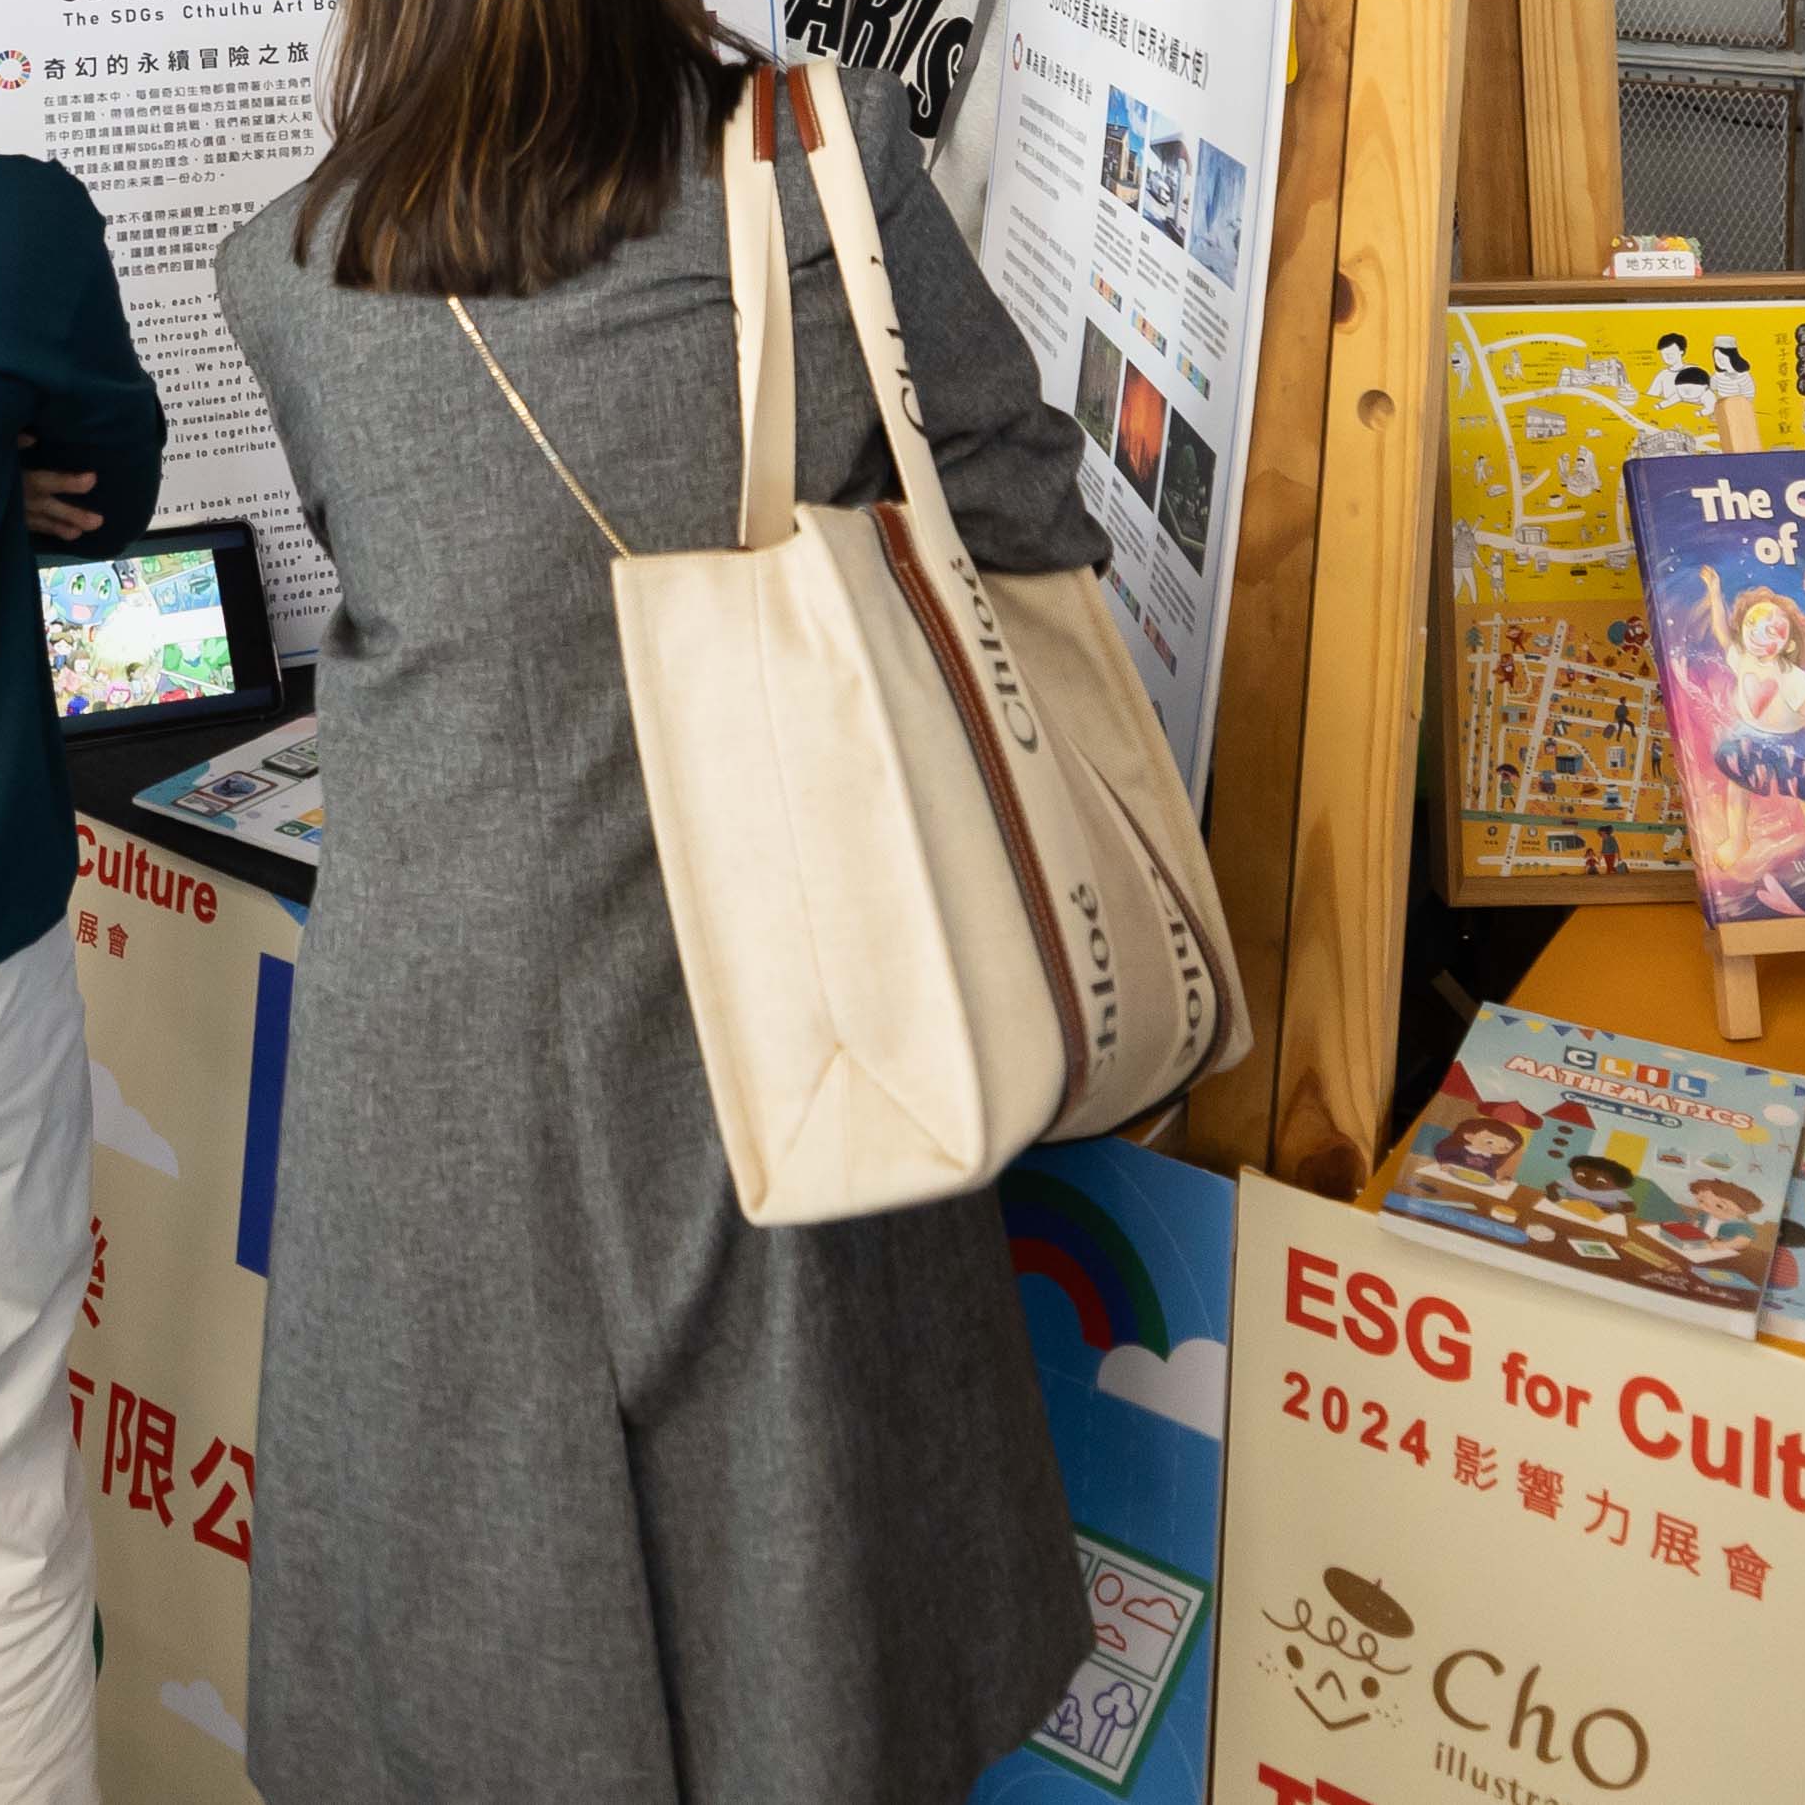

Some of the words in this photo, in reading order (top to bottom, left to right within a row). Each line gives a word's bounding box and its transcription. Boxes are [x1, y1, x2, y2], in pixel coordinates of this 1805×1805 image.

[63, 12, 100, 27] The
[111, 8, 165, 24] SDGs
[182, 0, 263, 19] Cthulhu
[43, 41, 310, 81] 奇幻的永續冒險之旅
[1625, 255, 1687, 273] 地方文化
[171, 296, 202, 307] each
[137, 312, 208, 328] adventures
[155, 329, 208, 343] through
[195, 363, 213, 373] We
[165, 379, 210, 393] adults
[217, 375, 241, 387] and
[187, 396, 227, 408] values
[231, 392, 242, 403] of
[183, 408, 250, 425] sustainable
[175, 432, 208, 443] lives
[196, 448, 208, 458] to
[213, 441, 277, 457] contribute
[175, 502, 195, 512] art
[200, 496, 232, 510] book
[237, 493, 258, 503] not
[264, 489, 291, 502] only
[1692, 478, 1772, 522] The
[1754, 522, 1797, 566] of
[283, 590, 313, 602] code
[318, 585, 341, 596] and
[76, 823, 218, 924] Culture
[76, 910, 129, 959] 展會
[1568, 1049, 1701, 1095] CLIL
[1505, 1055, 1755, 1130] MATHEMATICS
[1284, 1246, 1473, 1383] ESG
[1502, 1351, 1591, 1428] for
[1282, 1371, 1431, 1468] 2024
[1452, 1434, 1773, 1601] 影響力展會
[1435, 1741, 1561, 1805] illustr
